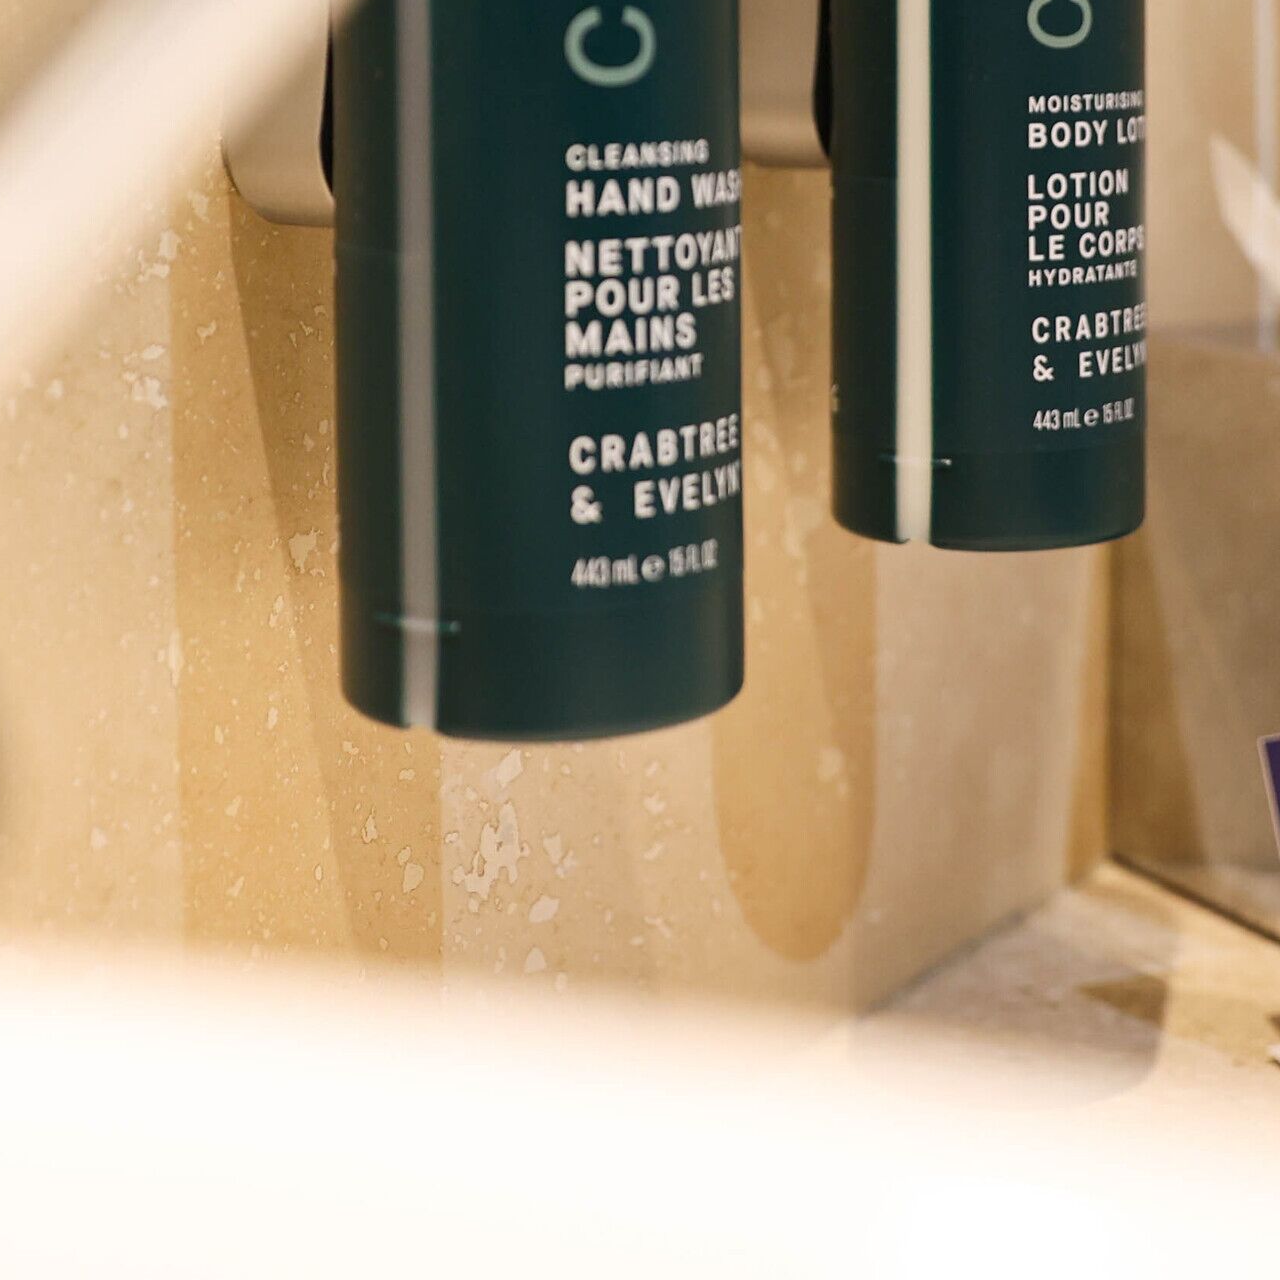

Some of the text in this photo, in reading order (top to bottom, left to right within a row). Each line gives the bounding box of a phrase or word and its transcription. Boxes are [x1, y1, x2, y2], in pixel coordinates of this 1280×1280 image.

[1028, 119, 1108, 149] BODY
[565, 138, 709, 171] CLEANSING
[565, 175, 681, 218] HAND
[1028, 168, 1129, 200] LOTION
[1028, 201, 1109, 231] POUR
[1028, 225, 1145, 261] LE CORPS
[565, 266, 735, 319] POUR LES
[565, 312, 697, 359] MAINS
[564, 352, 703, 392] PURIFIANT
[1033, 354, 1054, 382] &
[1033, 408, 1060, 431] 443
[1063, 408, 1081, 429] mL
[568, 413, 739, 475] CRABTREE
[570, 485, 603, 525] &
